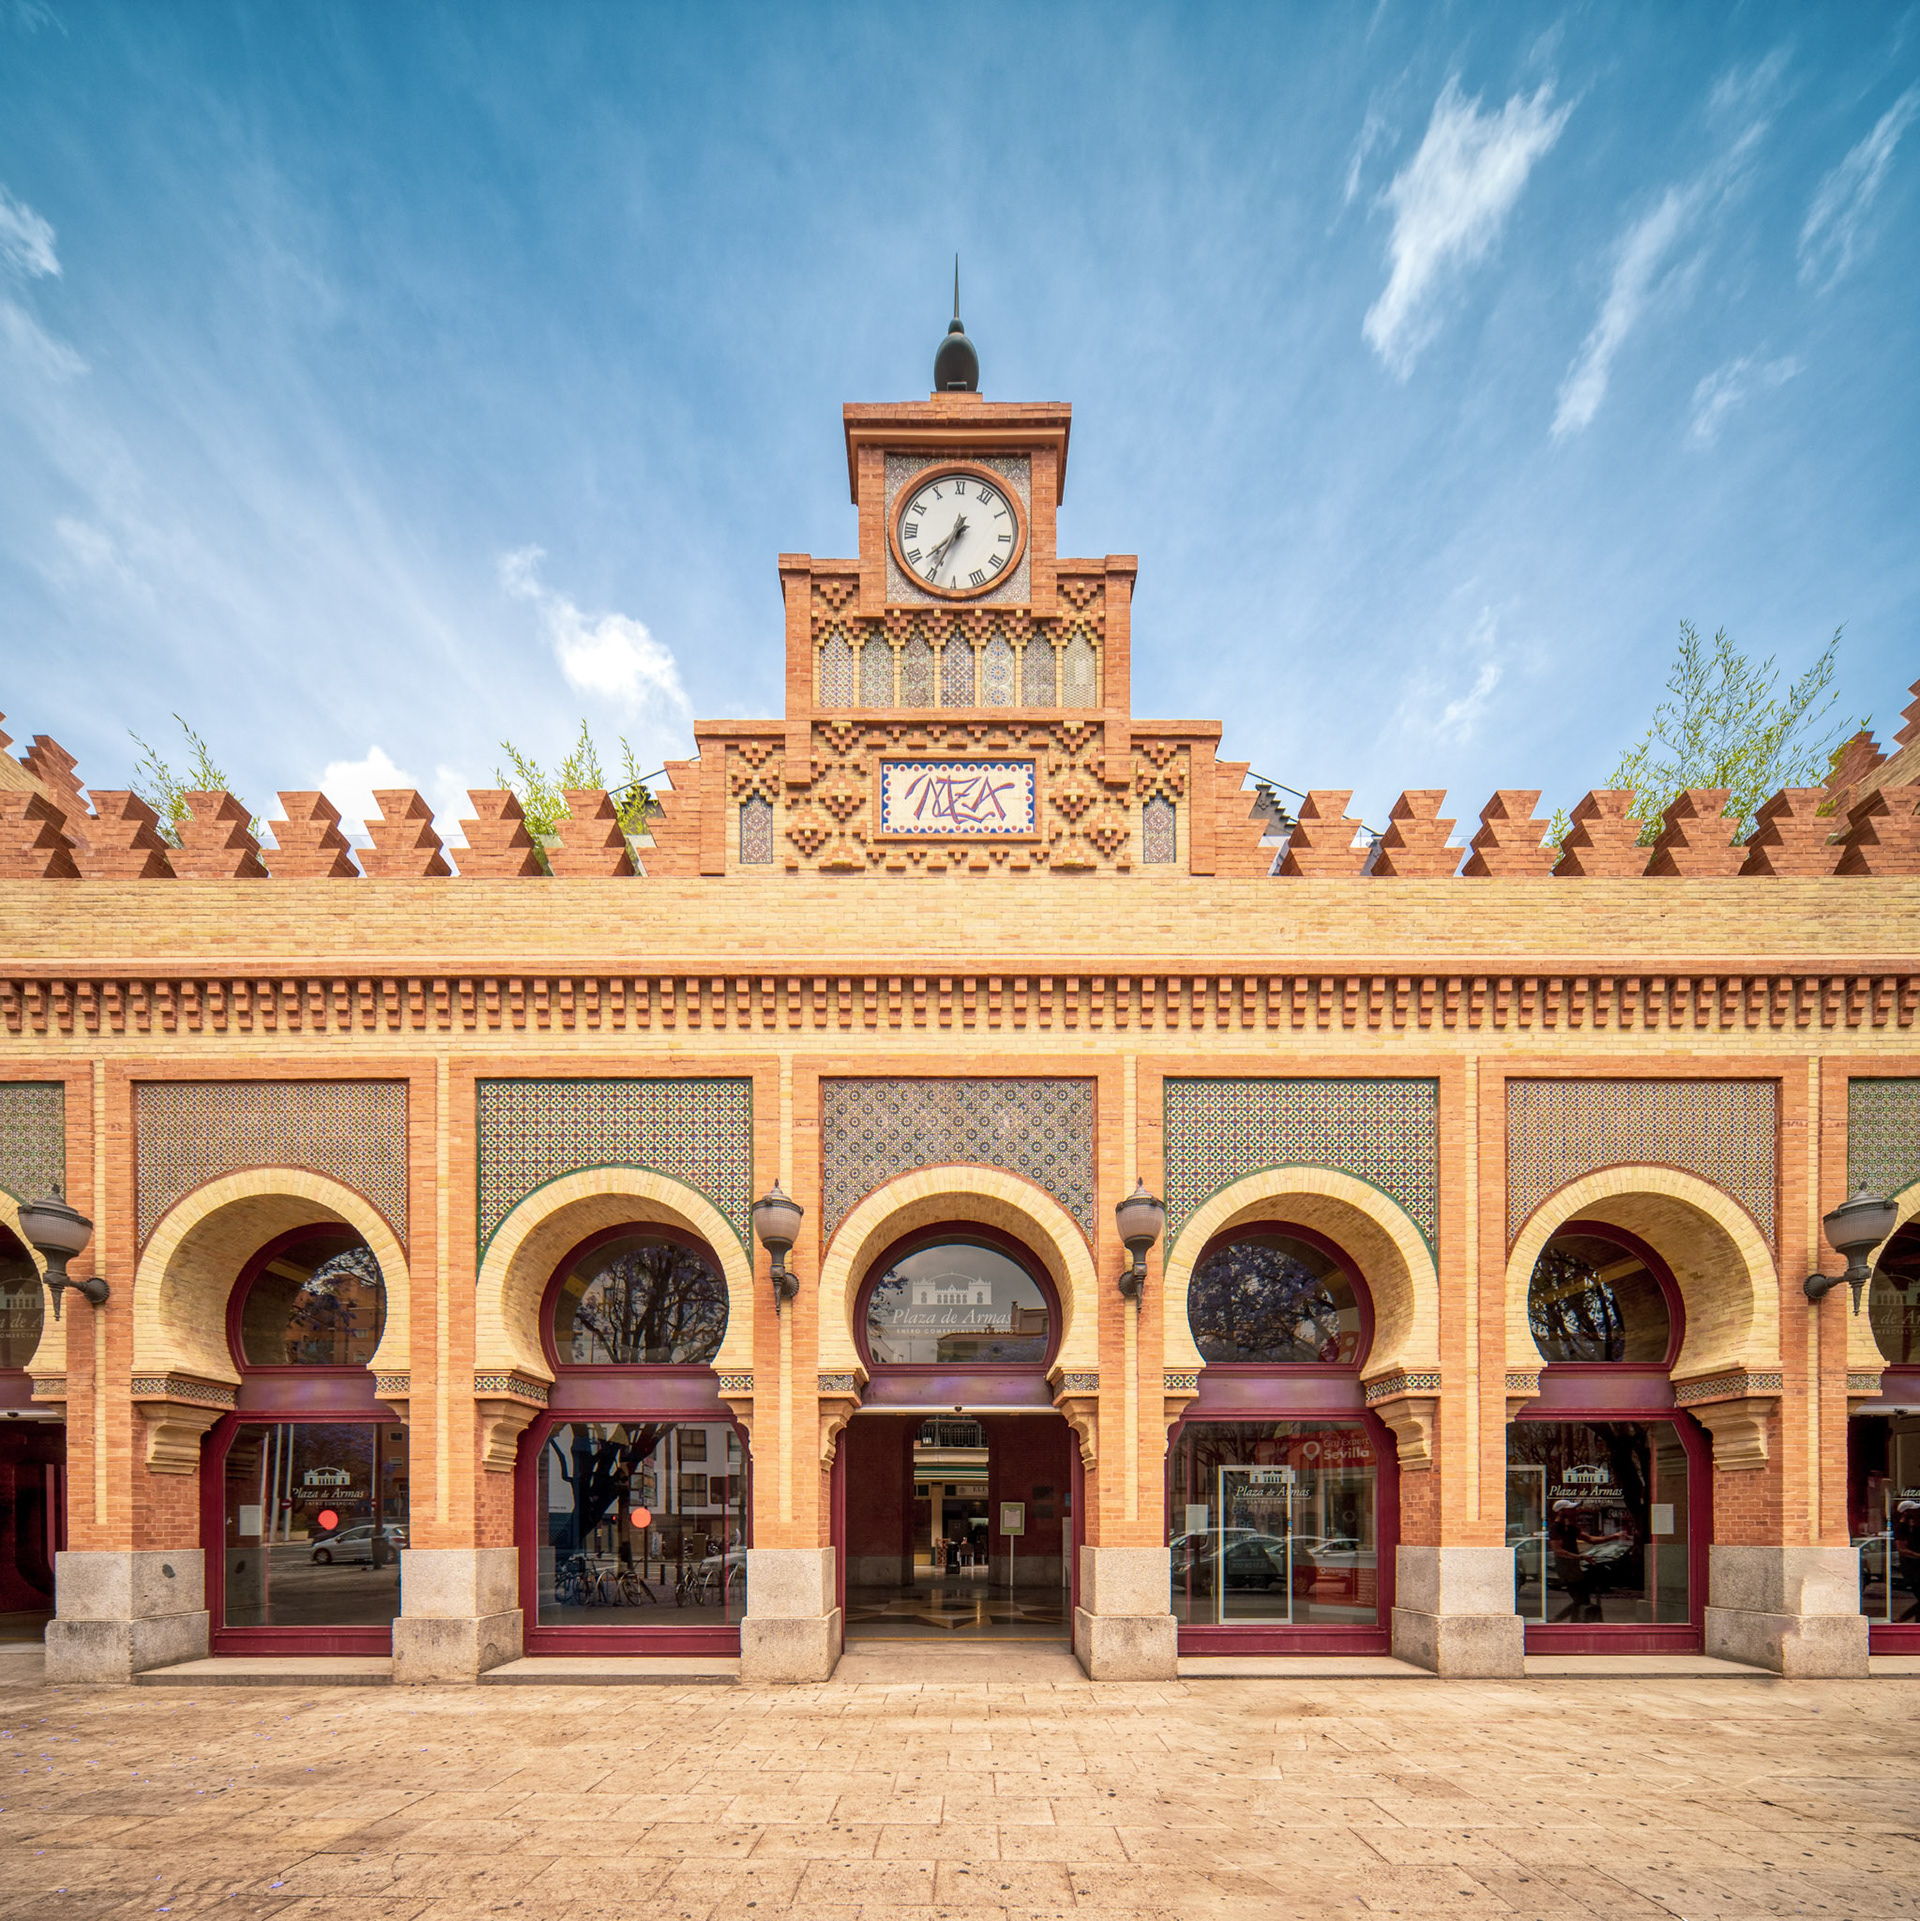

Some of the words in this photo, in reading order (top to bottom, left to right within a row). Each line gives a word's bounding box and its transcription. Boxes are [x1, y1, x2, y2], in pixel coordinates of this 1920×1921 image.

[892, 1308, 936, 1324] Plaza
[940, 1308, 958, 1324] de
[961, 1308, 1013, 1324] Armas
[1323, 1446, 1370, 1460] Sevilla
[321, 1489, 329, 1498] de
[331, 1487, 364, 1498] Armas
[1236, 1485, 1264, 1496] Plaza
[1277, 1485, 1310, 1496] Amas
[1549, 1485, 1577, 1496] Plaza
[1590, 1485, 1623, 1496] Armas
